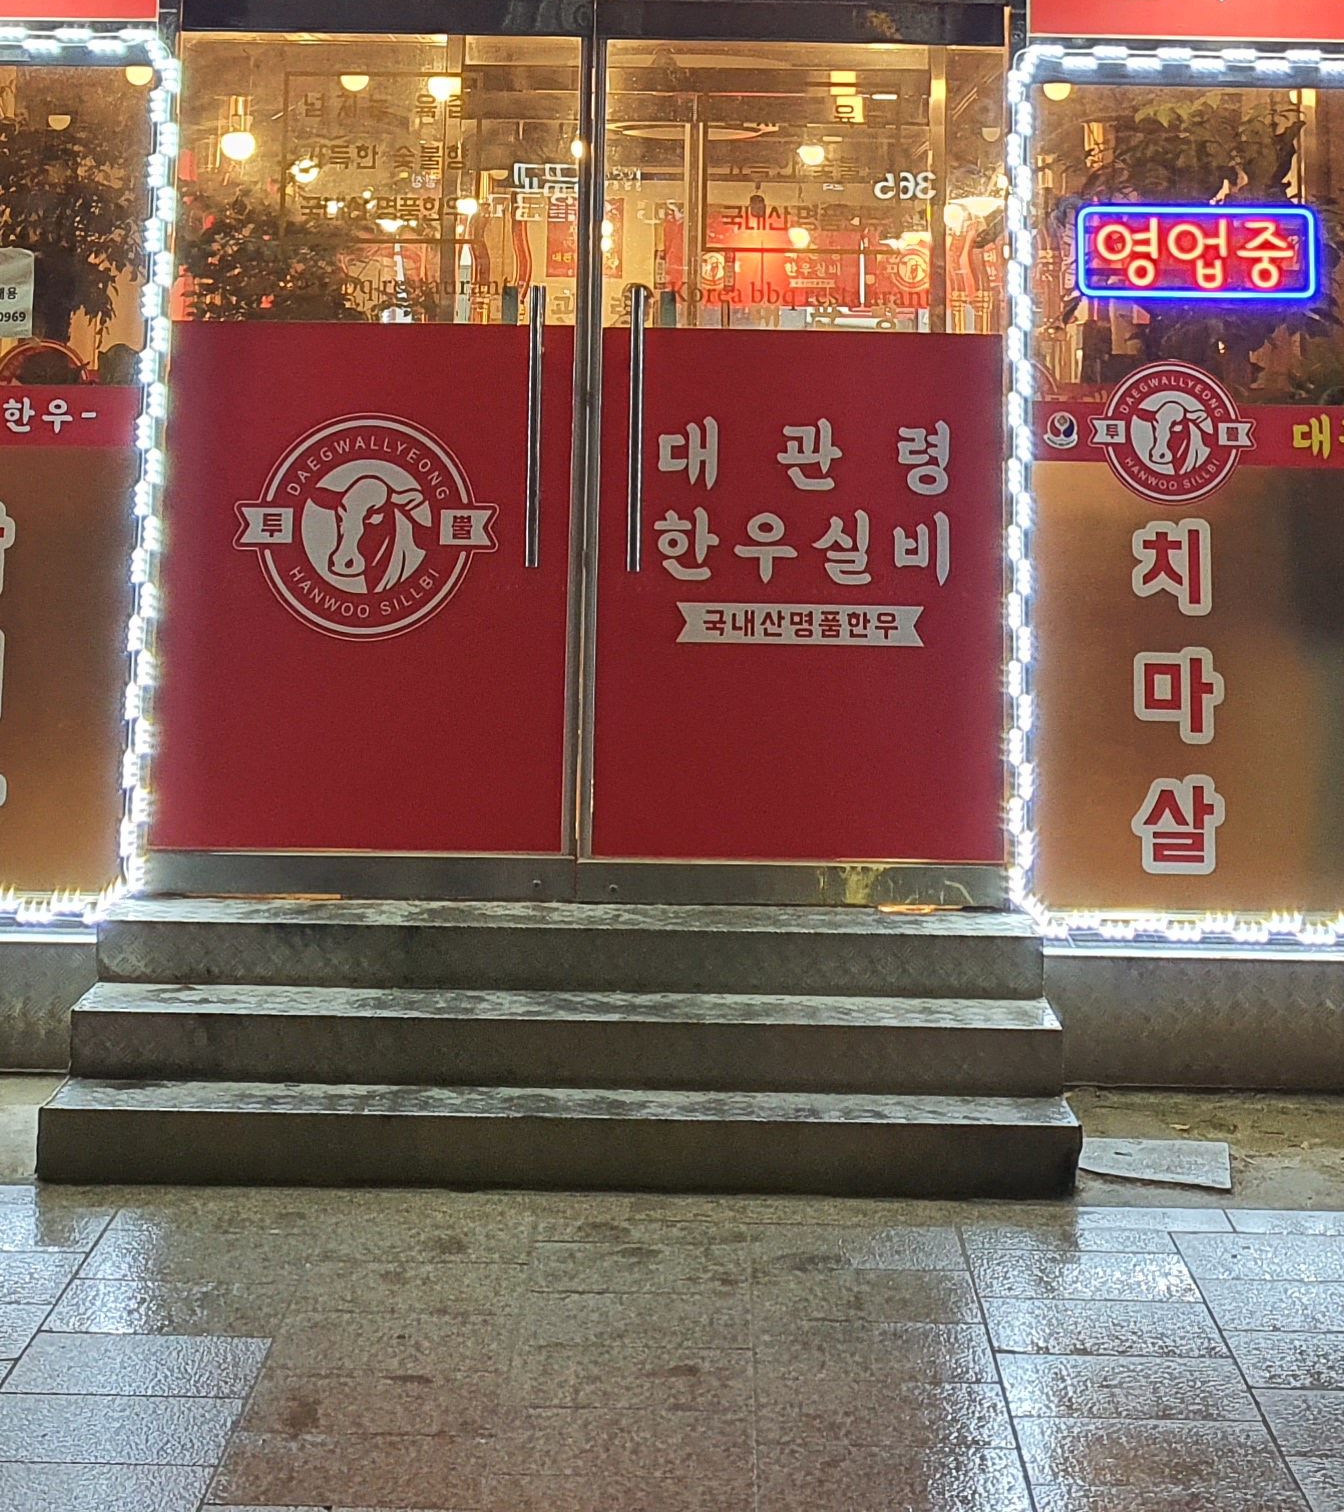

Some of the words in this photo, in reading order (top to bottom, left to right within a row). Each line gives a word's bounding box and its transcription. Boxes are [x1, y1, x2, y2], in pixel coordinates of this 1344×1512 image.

[1094, 216, 1296, 290] 영업중
[669, 281, 743, 305] Korea
[750, 278, 796, 310] bbq
[1119, 376, 1224, 418] DAEGWALLYEONG
[286, 435, 451, 502] DAEGWALLYEONG
[1124, 456, 1178, 491] HANWOO
[1182, 458, 1221, 490] SILLBI
[260, 512, 283, 539] 투
[653, 507, 953, 587] 한우실비
[288, 565, 371, 619] HANWOO
[380, 568, 440, 616] SILLBI
[702, 609, 901, 641] 국내산명품한우
[1141, 527, 1215, 864] 치마살
